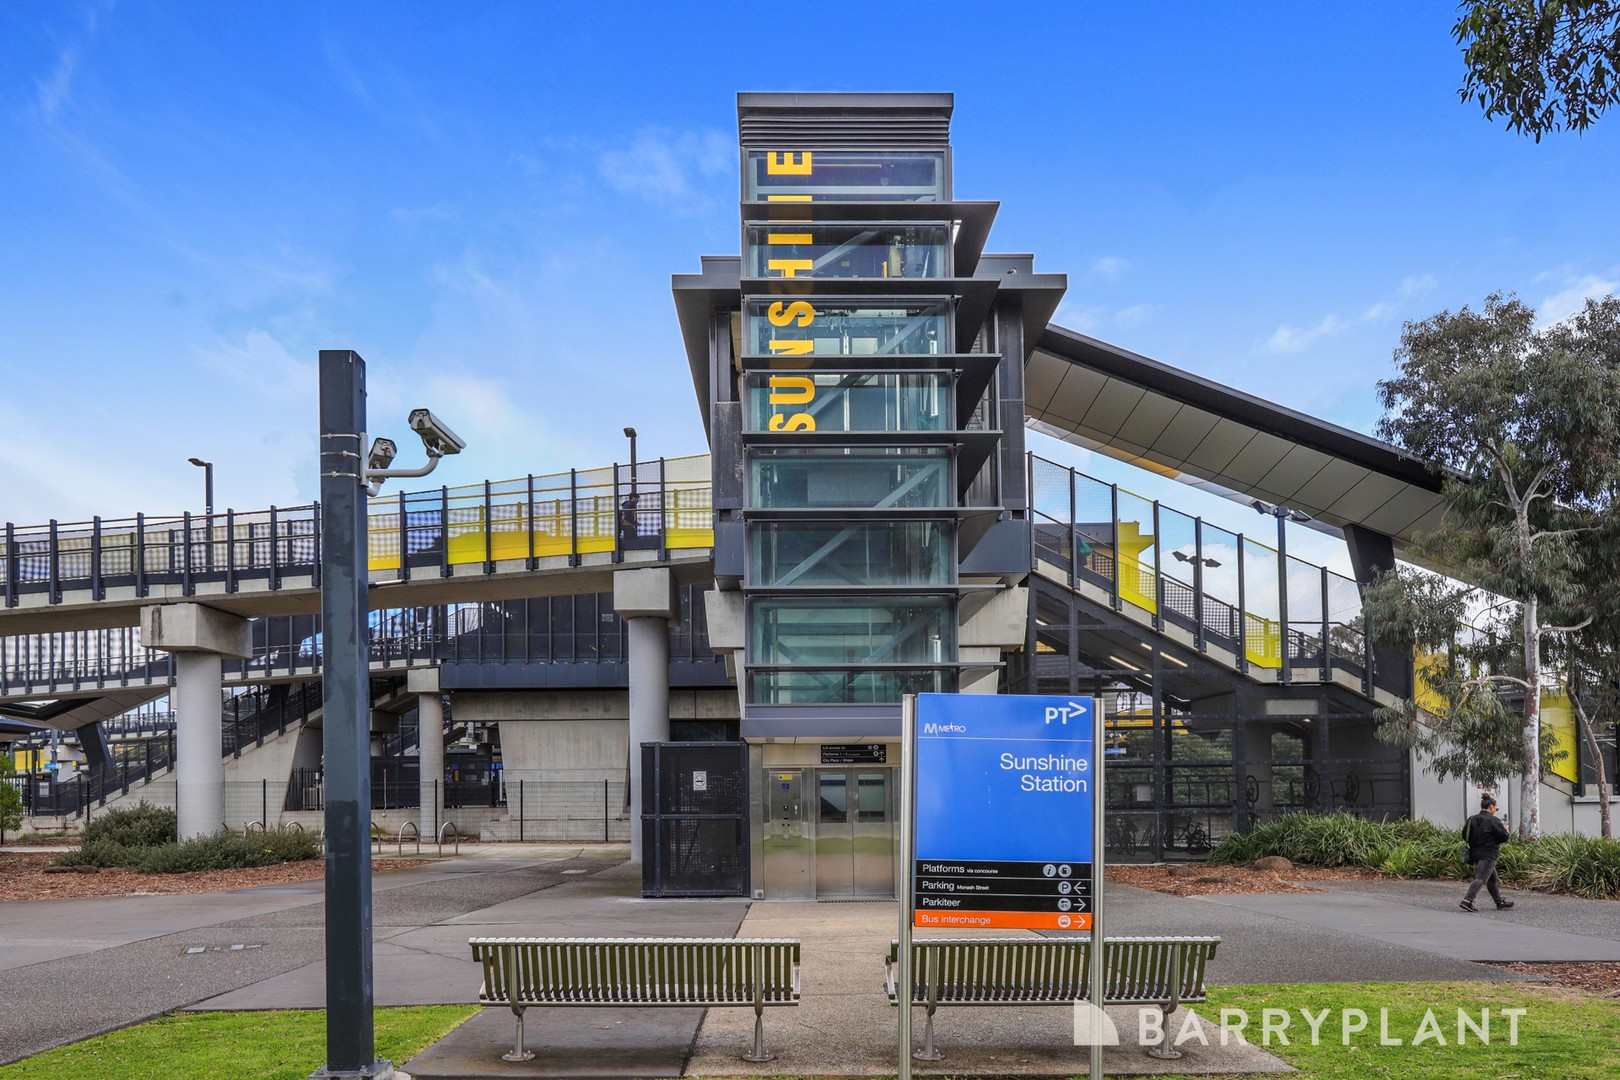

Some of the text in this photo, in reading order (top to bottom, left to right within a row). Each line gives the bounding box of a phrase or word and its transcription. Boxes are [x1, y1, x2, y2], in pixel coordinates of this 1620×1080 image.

[767, 151, 817, 432] SUNSHIE
[1000, 752, 1088, 771] Sunshine
[1021, 774, 1087, 793] Station
[922, 863, 965, 874] Platforms
[922, 880, 955, 892] Parking
[922, 897, 961, 907] Parkiteer
[921, 914, 991, 926] Bus interchange
